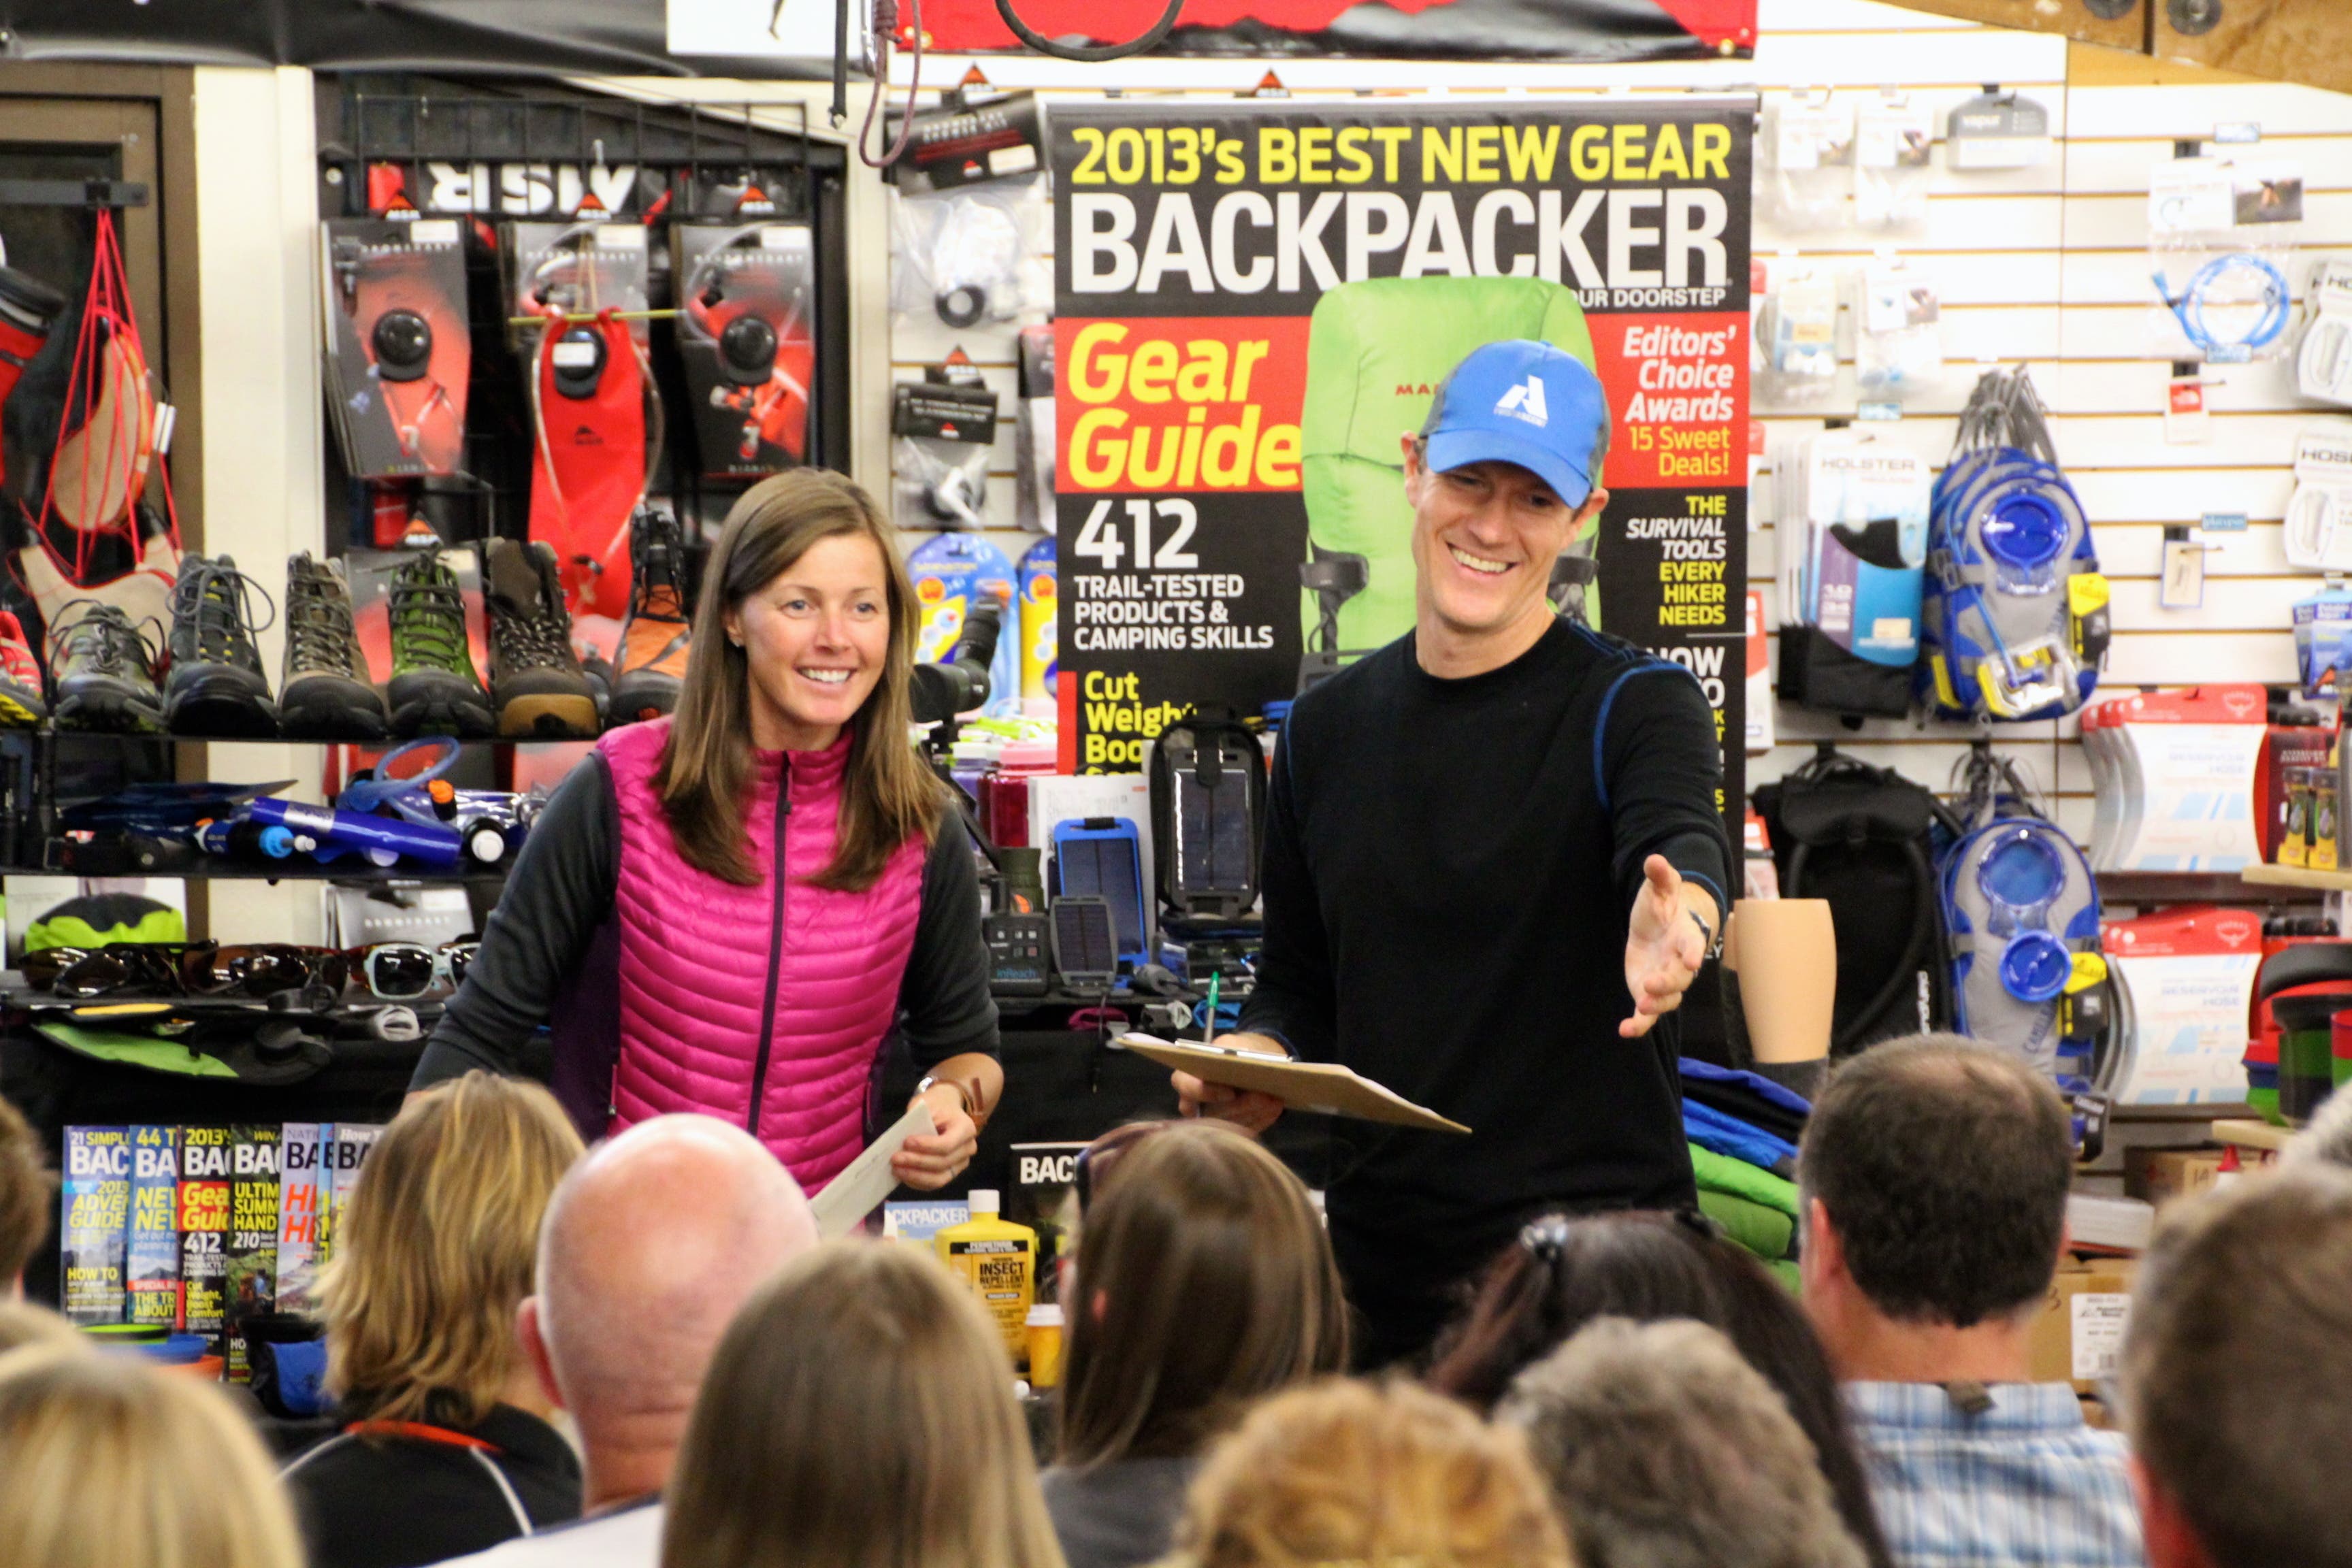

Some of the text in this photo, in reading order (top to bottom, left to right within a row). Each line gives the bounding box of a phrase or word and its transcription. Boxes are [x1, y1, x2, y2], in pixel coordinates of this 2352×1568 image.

[1072, 123, 1731, 184] 2013's BEST NEW GEAR
[1072, 187, 1729, 294] BACKPACKER
[1571, 288, 1726, 307] UR DOORSTEP
[1622, 324, 1737, 357] Editors'
[1068, 323, 1269, 404] Gear
[1639, 358, 1735, 389] Choice
[1395, 384, 1439, 396] MA
[1624, 389, 1735, 423] Awards
[1068, 406, 1301, 489] Guide
[1629, 425, 1731, 451] 15 Sweet
[1659, 451, 1730, 476] Deals!
[2302, 449, 2352, 464] HOS
[1685, 495, 1727, 515] THE
[1075, 499, 1198, 570] 412
[1625, 517, 1727, 538] SURVIVAL
[1662, 539, 1727, 559] TOOLS
[1659, 561, 1727, 581] EVERY
[1073, 574, 1244, 600] TRAIL-TESTED
[1664, 583, 1726, 604] HIKER
[1075, 600, 1229, 625] PRODUCTS &
[1659, 605, 1727, 625] NEEDS
[1075, 624, 1275, 651] CAMPING SKILLS
[1646, 646, 1725, 676] OW
[1085, 670, 1140, 701] Cut
[86, 1132, 129, 1146] SIMPL
[137, 1128, 162, 1146] 44
[184, 1146, 230, 1176] BA
[235, 1144, 281, 1174] BA
[1021, 1155, 1079, 1184] BAC
[69, 1211, 126, 1228] GUIDE
[234, 1215, 277, 1230] HAND
[887, 1207, 969, 1226] CKPACKER
[184, 1232, 221, 1254] 412
[233, 1232, 260, 1248] 210
[67, 1267, 118, 1280] HOW TO
[979, 1262, 1025, 1276] INSECT
